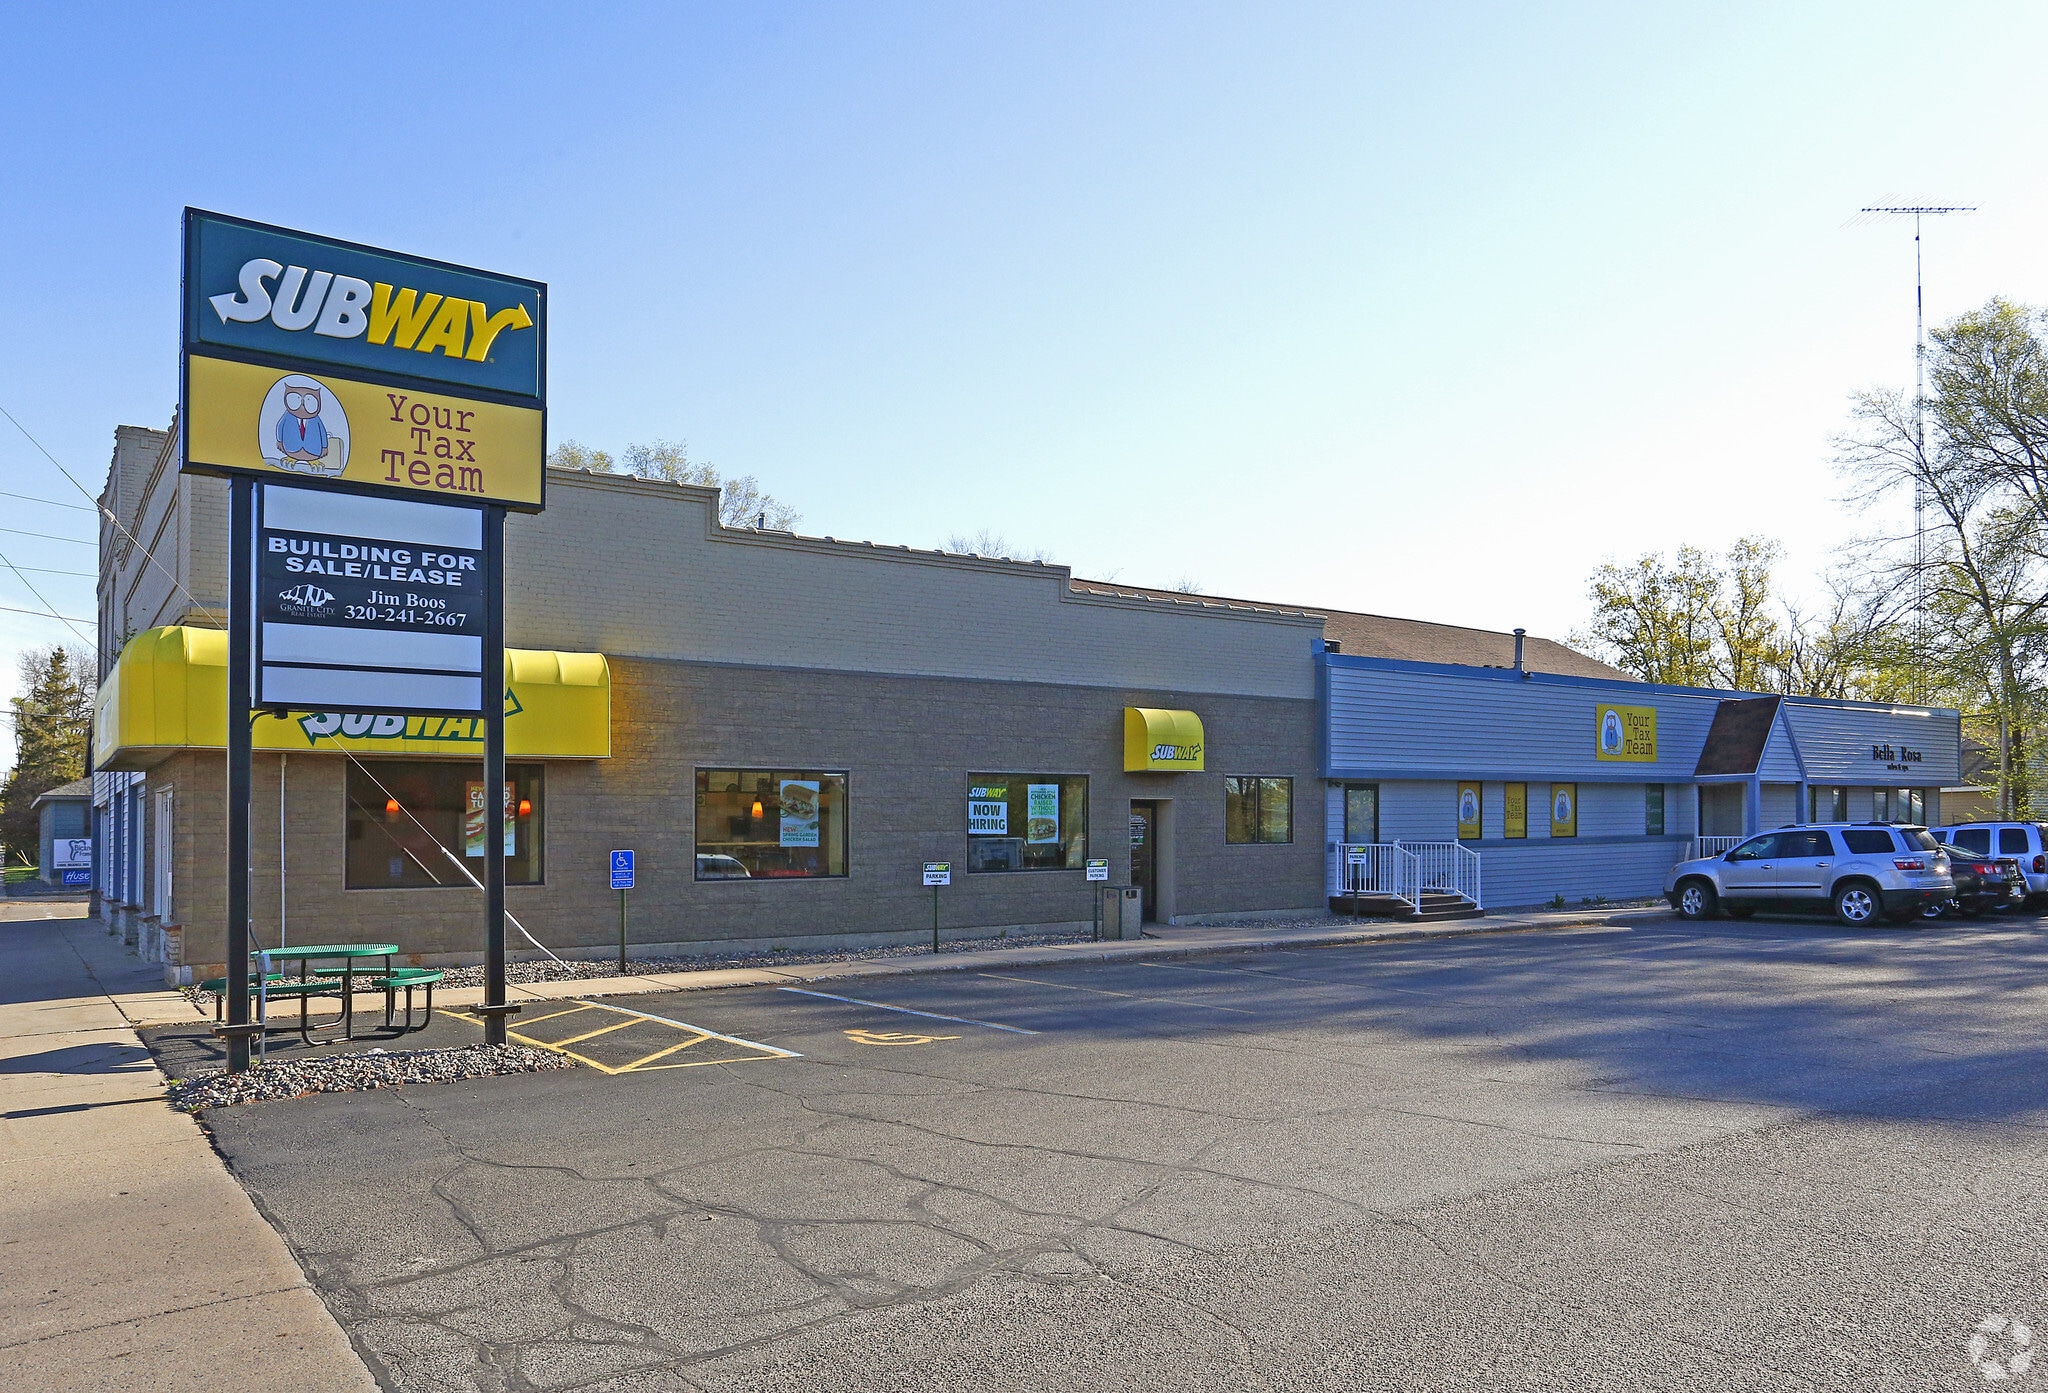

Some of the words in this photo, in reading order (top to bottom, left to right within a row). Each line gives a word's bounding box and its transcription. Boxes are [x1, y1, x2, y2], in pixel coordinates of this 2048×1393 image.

[209, 258, 533, 363] SUBWAY
[387, 394, 475, 433] Your
[410, 427, 476, 462] Tax
[381, 449, 484, 493] Team
[268, 537, 411, 565] BUILDING
[421, 552, 476, 571] FOR
[285, 557, 462, 587] SALE/LEASE
[280, 603, 314, 613] GRANITE
[316, 606, 336, 615] CITY
[367, 590, 400, 606] Jim
[406, 593, 446, 609] Boos
[344, 605, 467, 627] 320-241-2667
[1627, 713, 1649, 726] Your
[1633, 727, 1650, 741] Tax
[1150, 743, 1202, 763] SUBWAY
[1626, 739, 1653, 755] Team
[1873, 744, 1895, 761] Bella
[1901, 746, 1922, 762] Rosa
[969, 787, 1007, 798] SUBWAY
[973, 804, 1001, 816] NOW
[969, 818, 1005, 831] HIRING
